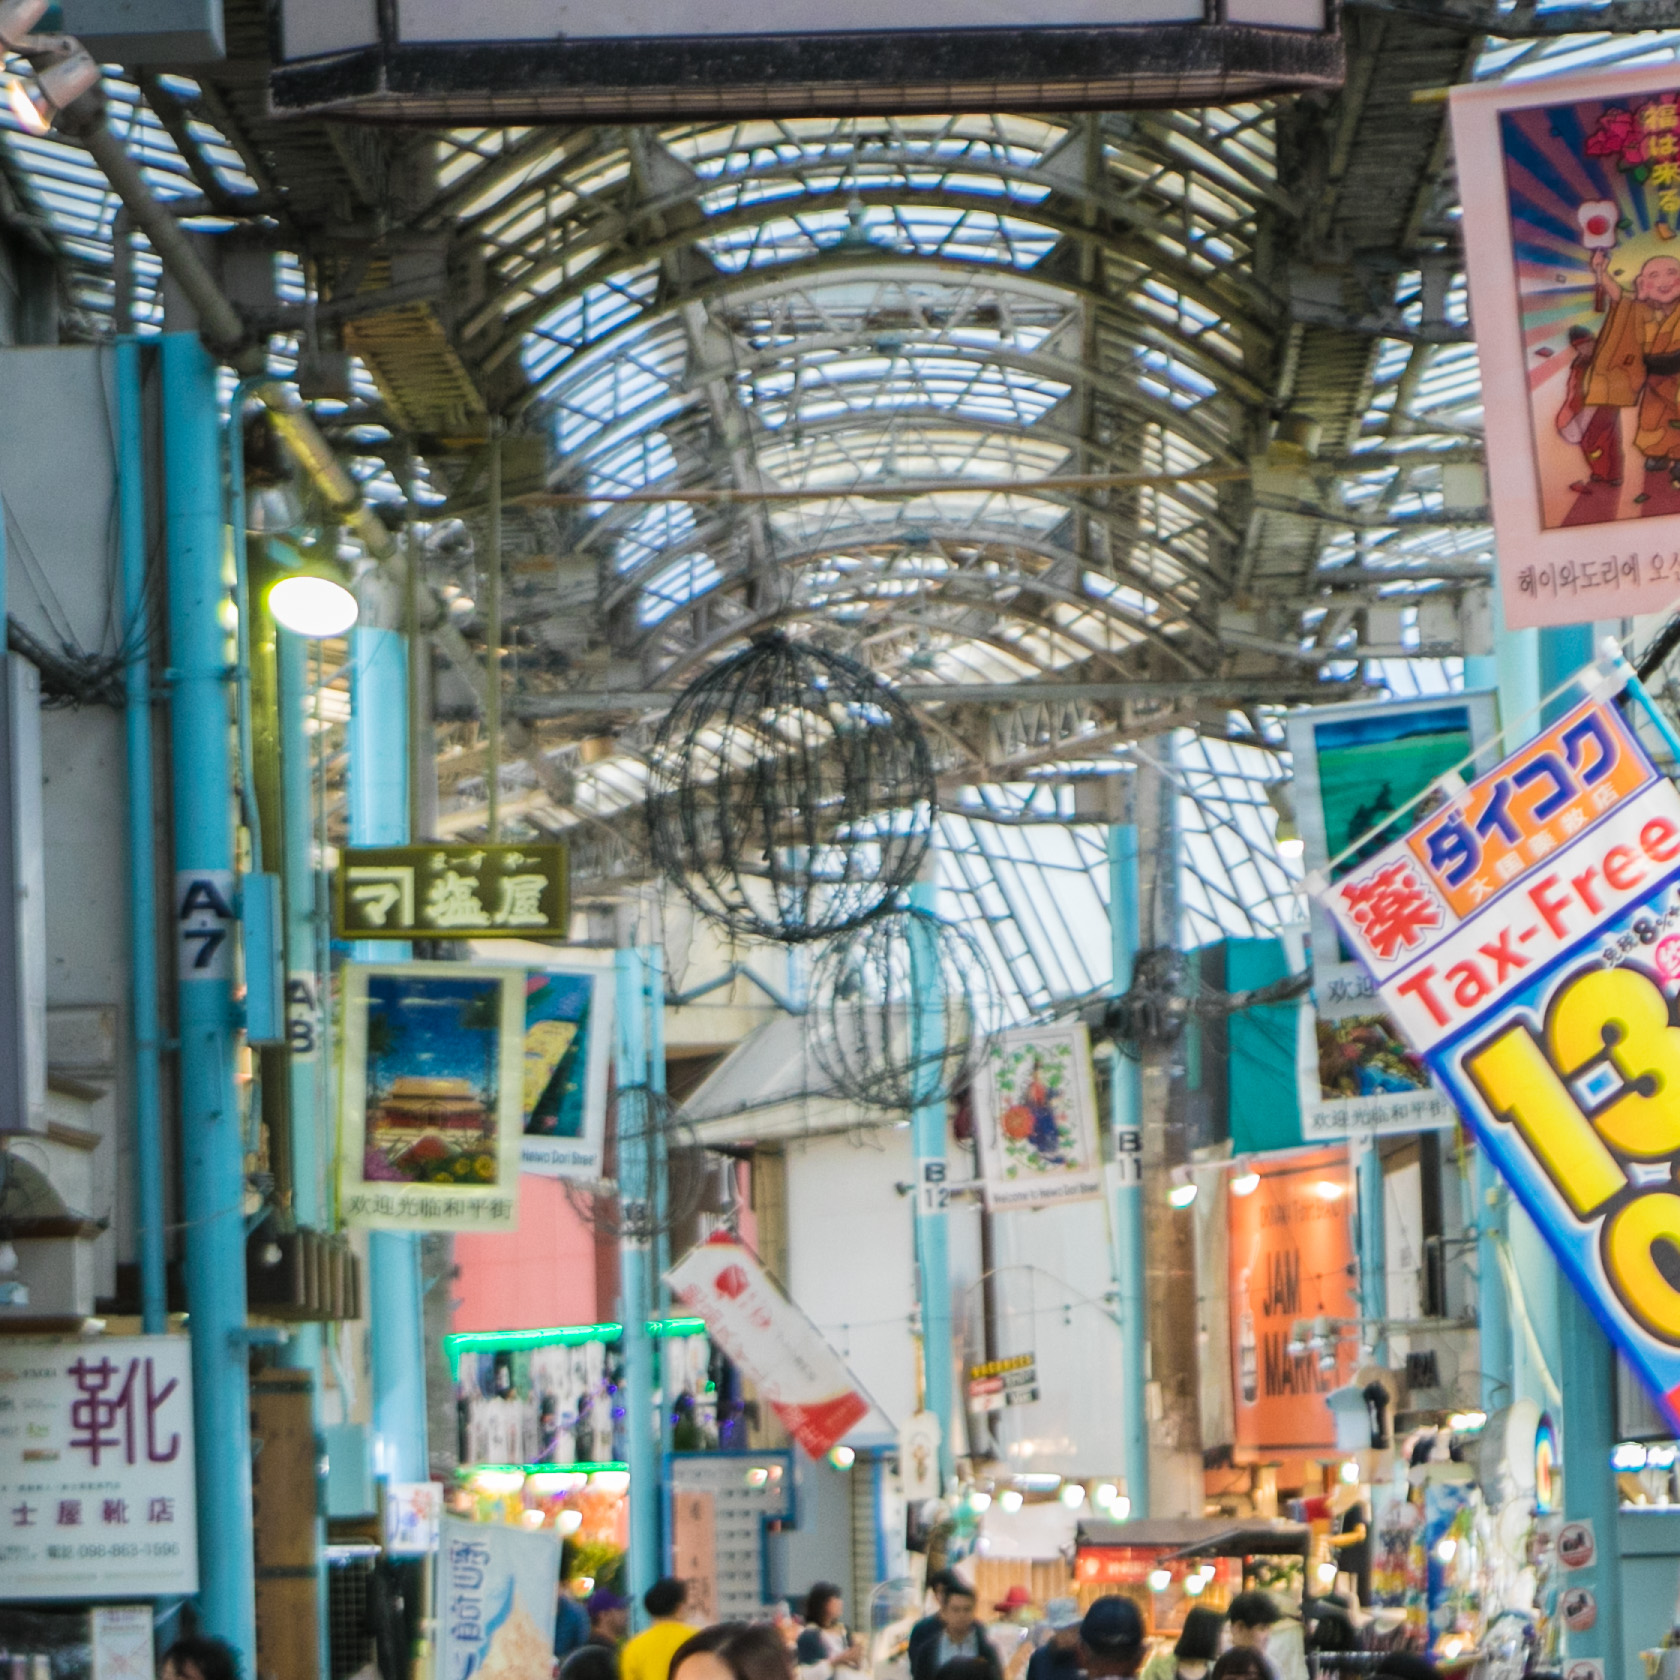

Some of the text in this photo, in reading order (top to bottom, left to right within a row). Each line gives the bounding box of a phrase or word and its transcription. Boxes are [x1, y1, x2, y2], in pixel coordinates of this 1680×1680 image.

[1425, 706, 1620, 887] ダイコク
[1340, 856, 1446, 962] 薬
[66, 1356, 180, 1468] 靴
